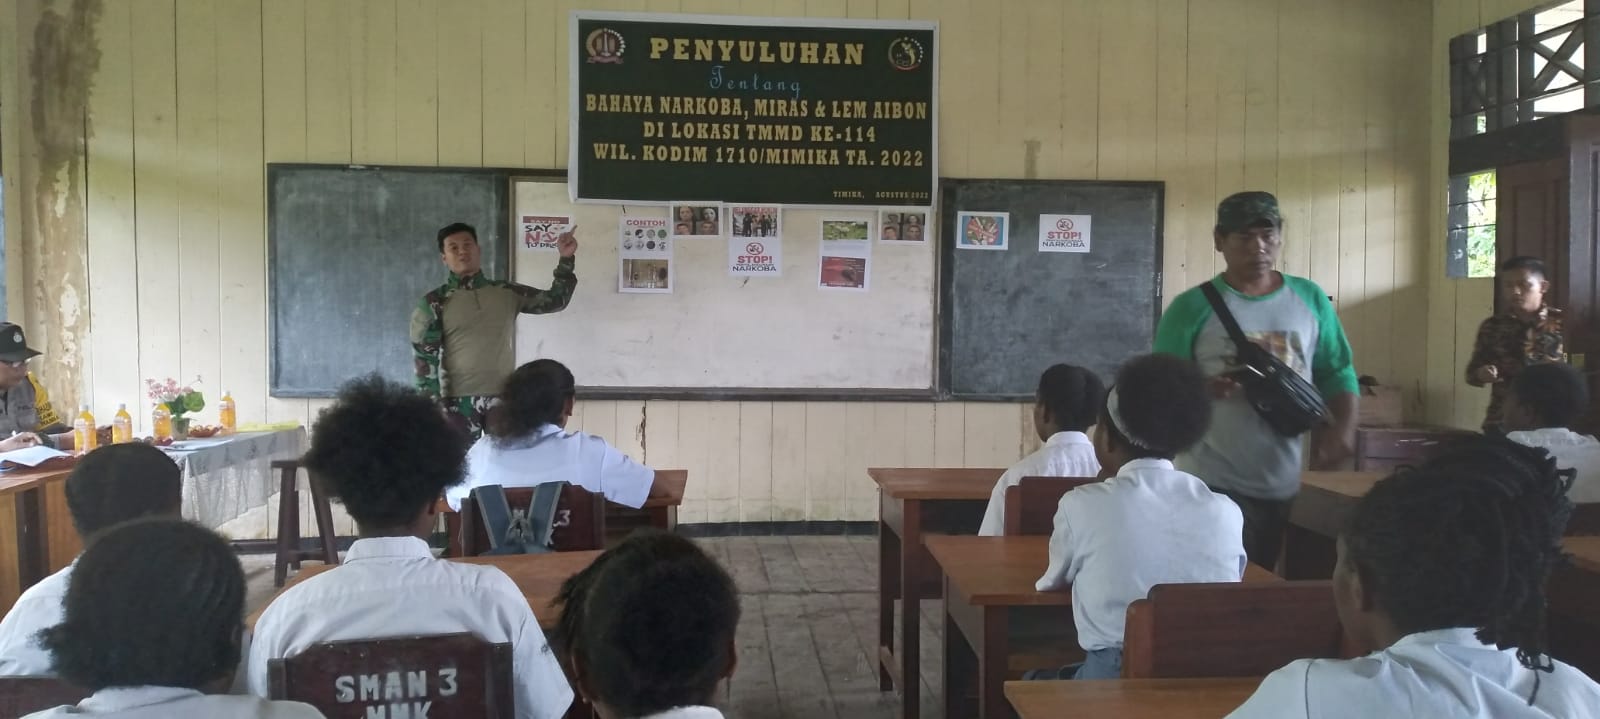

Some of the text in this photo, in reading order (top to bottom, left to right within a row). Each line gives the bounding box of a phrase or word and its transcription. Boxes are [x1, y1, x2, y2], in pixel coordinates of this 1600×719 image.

[650, 37, 864, 65] PENYULUHAN
[708, 65, 801, 99] Tentang
[586, 93, 927, 120] BAHAYA NARKOBA, MIRAS & LEM AIBON
[643, 122, 876, 143] DI LOKASI TMMD KE-114
[593, 143, 924, 167] WIL. KODIM 1710/MIMIKA TA. 2022
[525, 223, 552, 232] SAY
[737, 255, 773, 264] STOP!
[335, 668, 457, 703] SMAN 3
